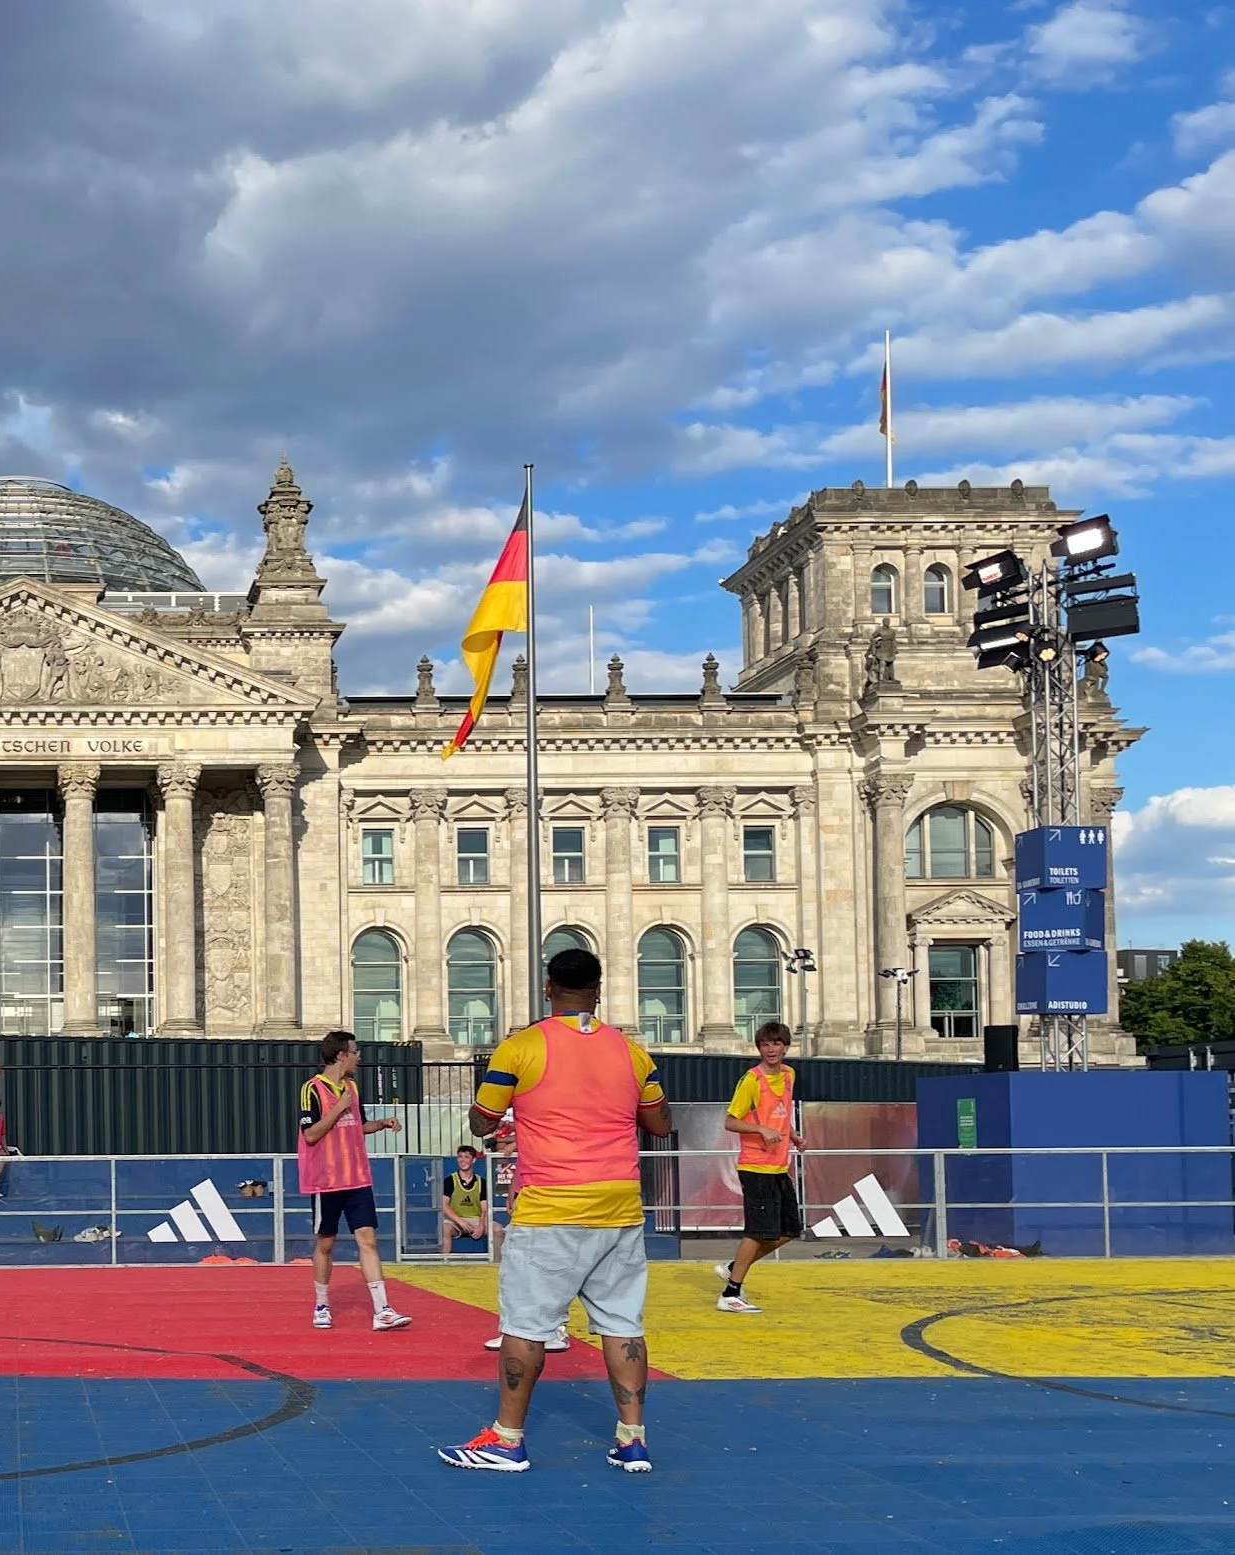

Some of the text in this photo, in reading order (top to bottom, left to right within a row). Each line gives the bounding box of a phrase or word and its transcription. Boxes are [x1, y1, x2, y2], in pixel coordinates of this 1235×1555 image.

[87, 740, 144, 753] VOLKE
[1049, 867, 1078, 876] TOILETS
[1049, 876, 1080, 884] TOILETTEN
[1048, 1000, 1088, 1010] ADISTUDIO
